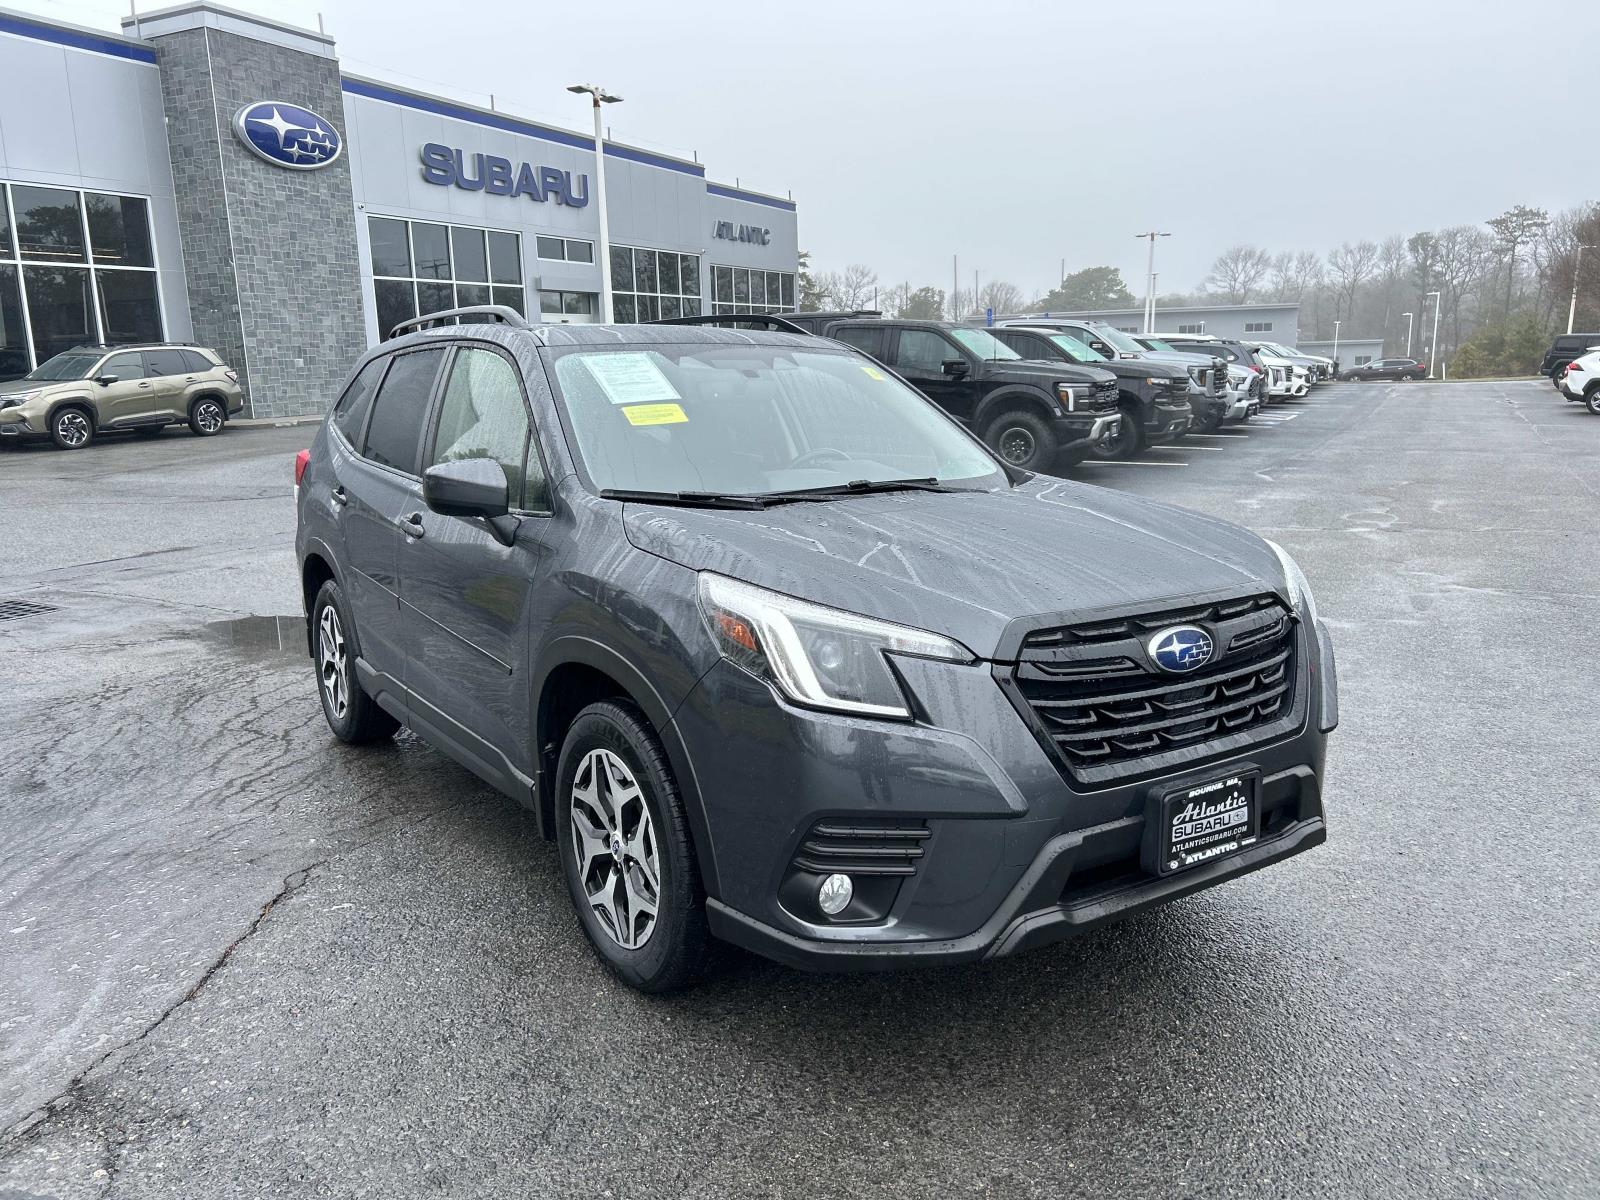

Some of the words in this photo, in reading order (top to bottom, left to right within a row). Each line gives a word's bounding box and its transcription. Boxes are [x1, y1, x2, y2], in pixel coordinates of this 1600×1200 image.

[420, 142, 589, 208] SUBARU
[712, 219, 771, 245] ATLANTIC
[1172, 791, 1247, 825] Atlantic
[1171, 825, 1248, 853] ATLANTICSUBARU.COM
[1174, 813, 1231, 840] SUBARU
[1185, 841, 1238, 864] ATLANTIC
